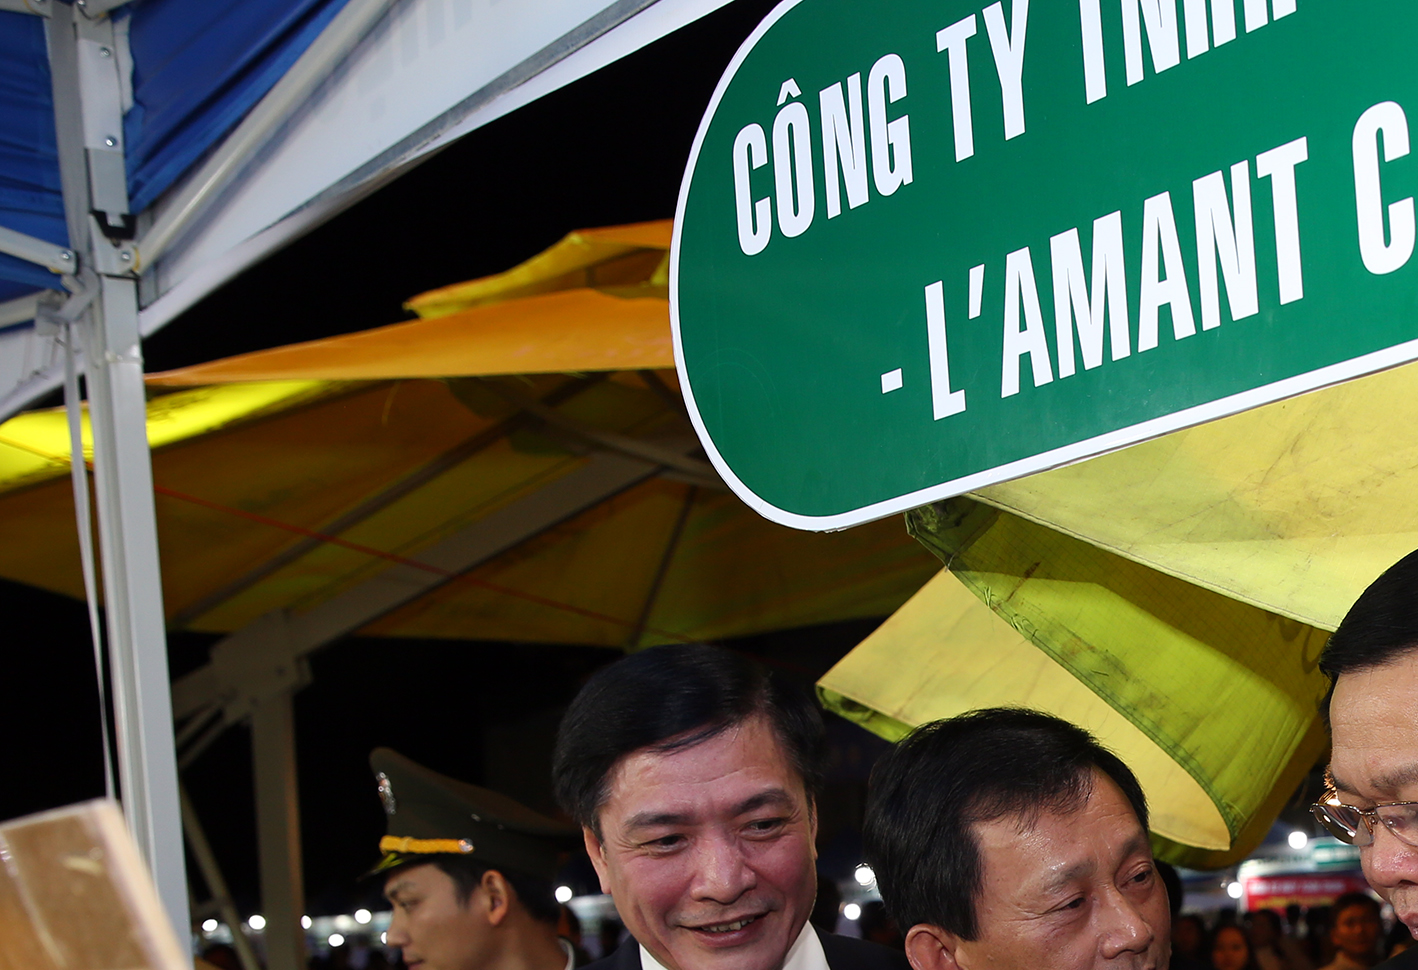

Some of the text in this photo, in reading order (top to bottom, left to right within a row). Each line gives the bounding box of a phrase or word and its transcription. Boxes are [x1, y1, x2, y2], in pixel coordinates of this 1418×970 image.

[733, 53, 914, 256] CÔNG
[936, 0, 1029, 163] TY
[925, 136, 1309, 420] L'AMANT
